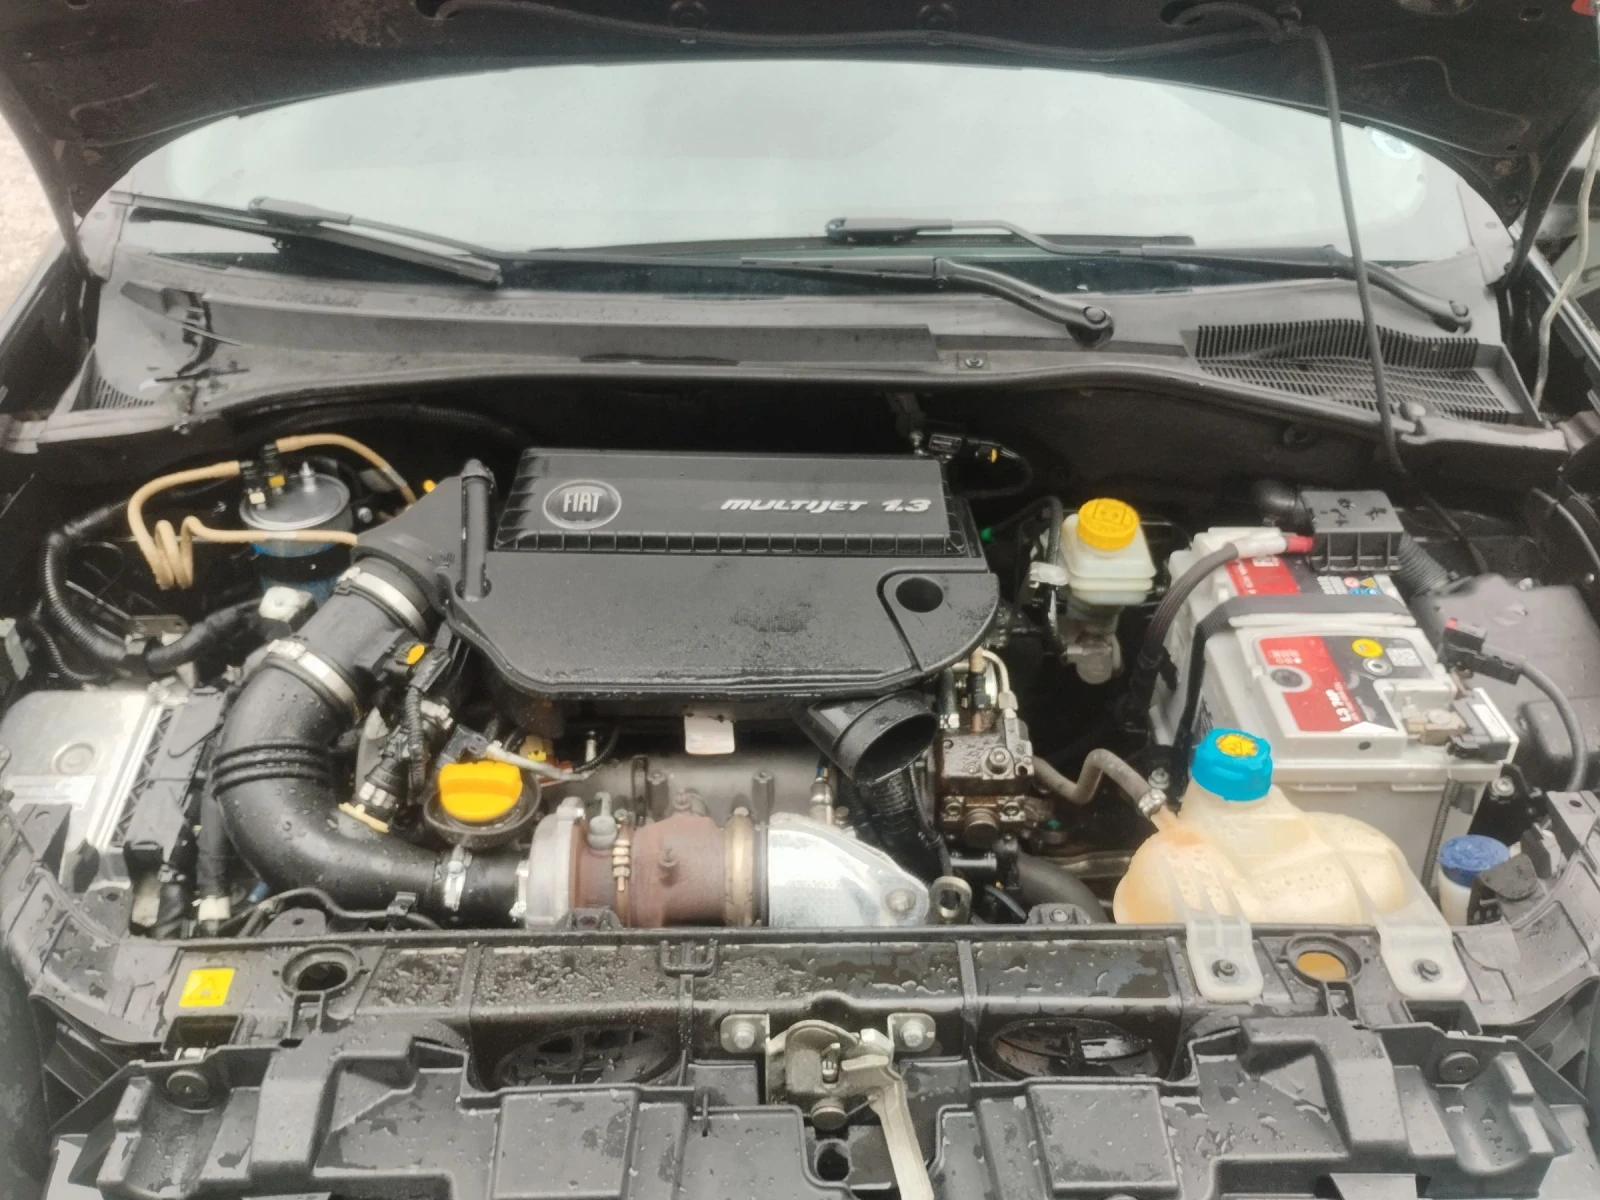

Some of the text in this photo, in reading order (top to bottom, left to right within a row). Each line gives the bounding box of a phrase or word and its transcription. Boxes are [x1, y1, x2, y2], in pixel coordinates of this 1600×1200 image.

[563, 492, 603, 513] FIAT
[720, 499, 932, 513] MULTIJET 1.3
